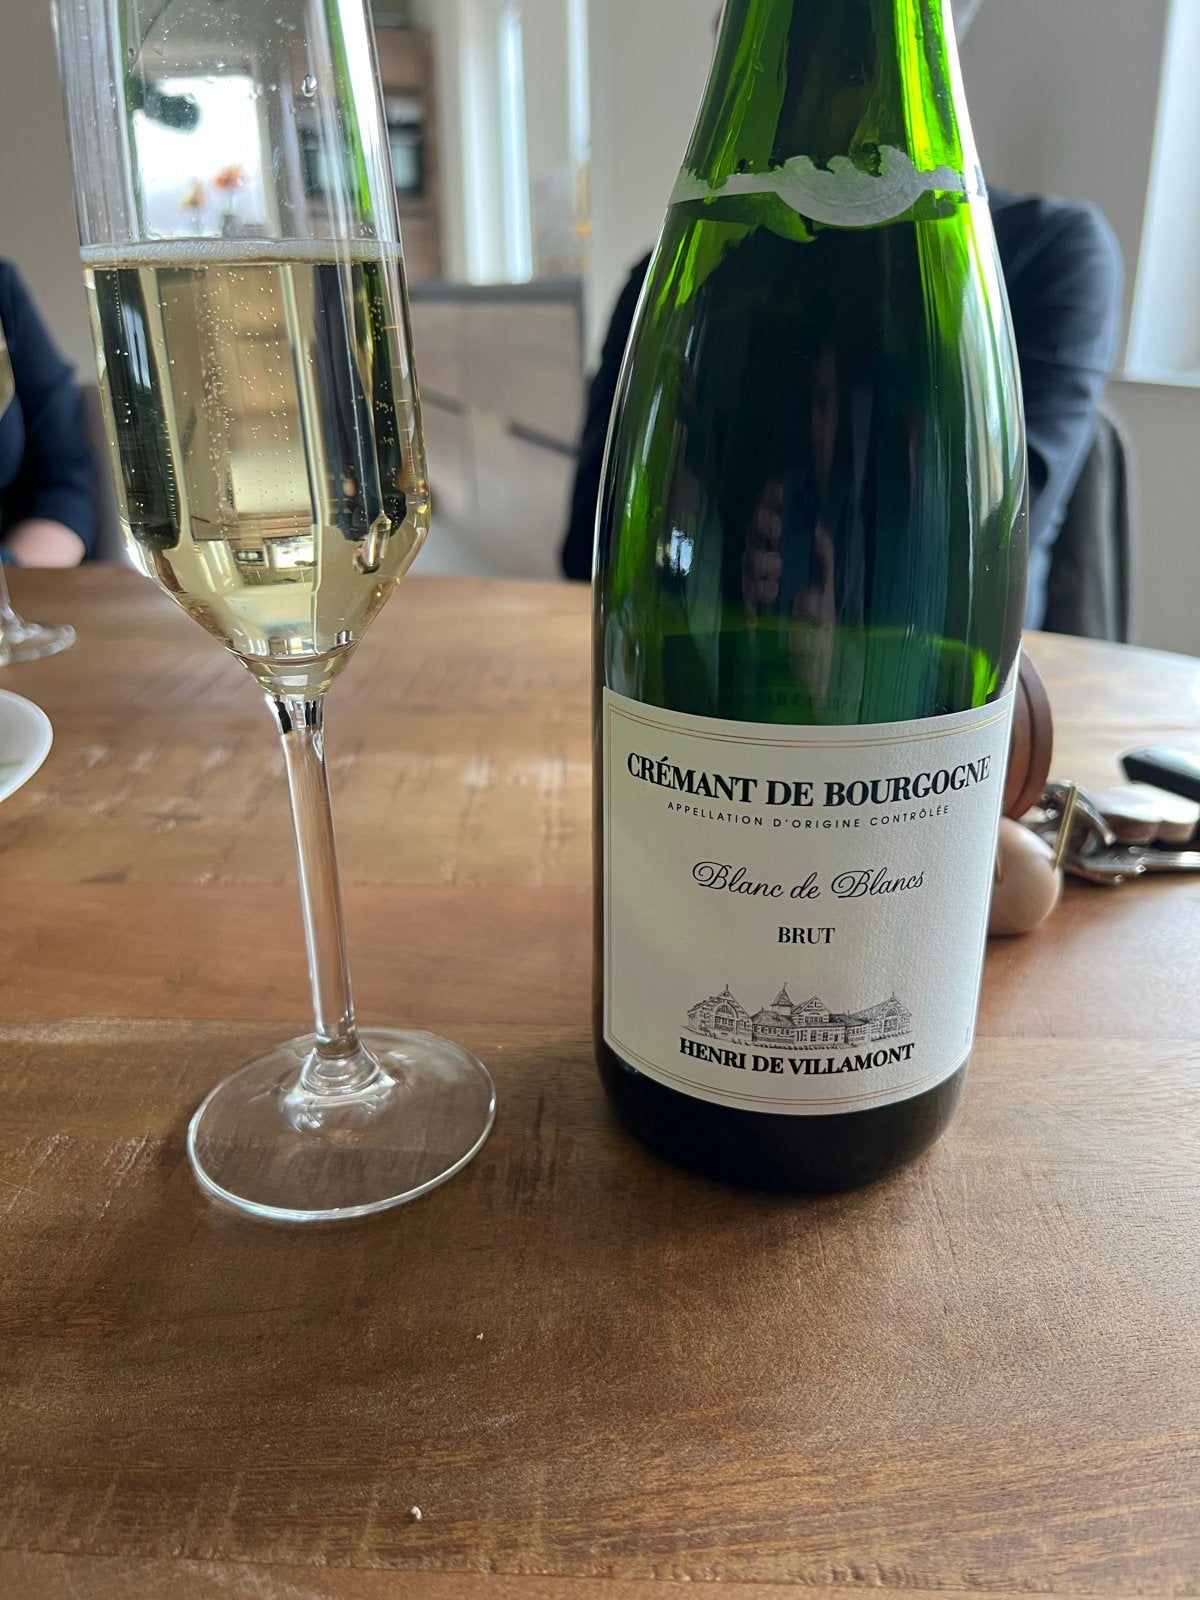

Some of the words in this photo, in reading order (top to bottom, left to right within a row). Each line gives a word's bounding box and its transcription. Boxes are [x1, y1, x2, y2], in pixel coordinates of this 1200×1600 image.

[627, 752, 757, 803] CRÉMANT
[765, 780, 813, 807] DE
[823, 755, 991, 807] BOURGOGNE
[667, 801, 763, 826] APPELLATION
[773, 819, 861, 828] D'ORIGINE
[870, 804, 950, 826] CONTRÔLÉE
[692, 861, 784, 898] Blanc
[789, 872, 821, 899] de
[831, 869, 924, 899] Blancs
[777, 926, 836, 944] BRUT
[679, 1037, 746, 1070] HENRI
[751, 1055, 784, 1074] DE
[788, 1042, 915, 1075] VILLAMONT
